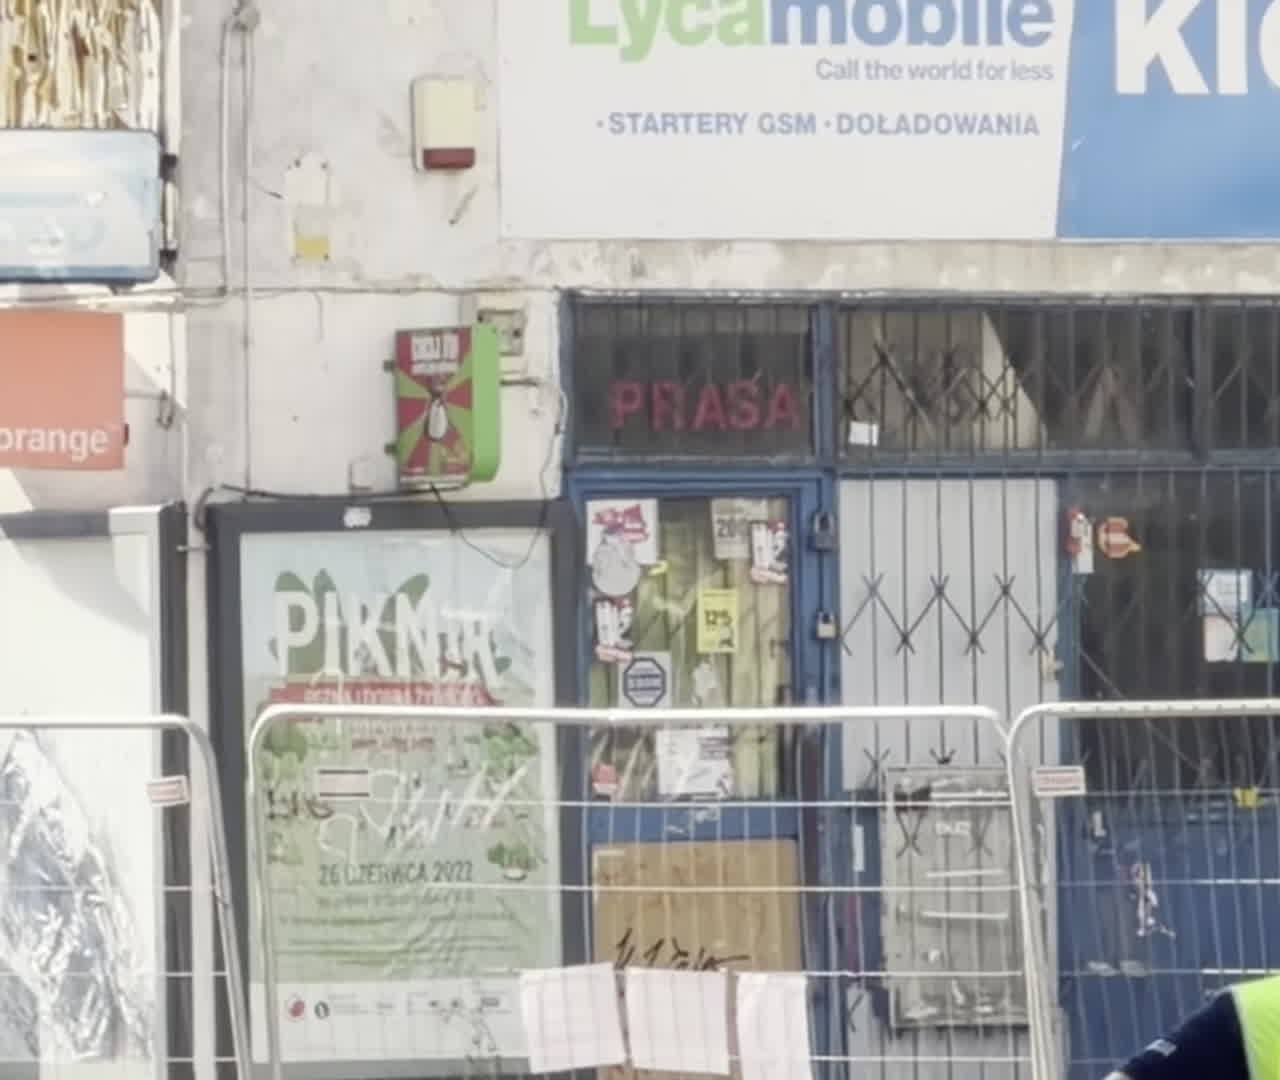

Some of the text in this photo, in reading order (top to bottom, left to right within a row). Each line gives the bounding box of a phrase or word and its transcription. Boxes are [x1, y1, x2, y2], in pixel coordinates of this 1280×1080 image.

[815, 59, 1054, 81] Call the world for less
[608, 112, 1040, 136] STARTERY GSM DOŁADOWANIA
[608, 380, 801, 431] PRASA
[0, 427, 109, 463] orange
